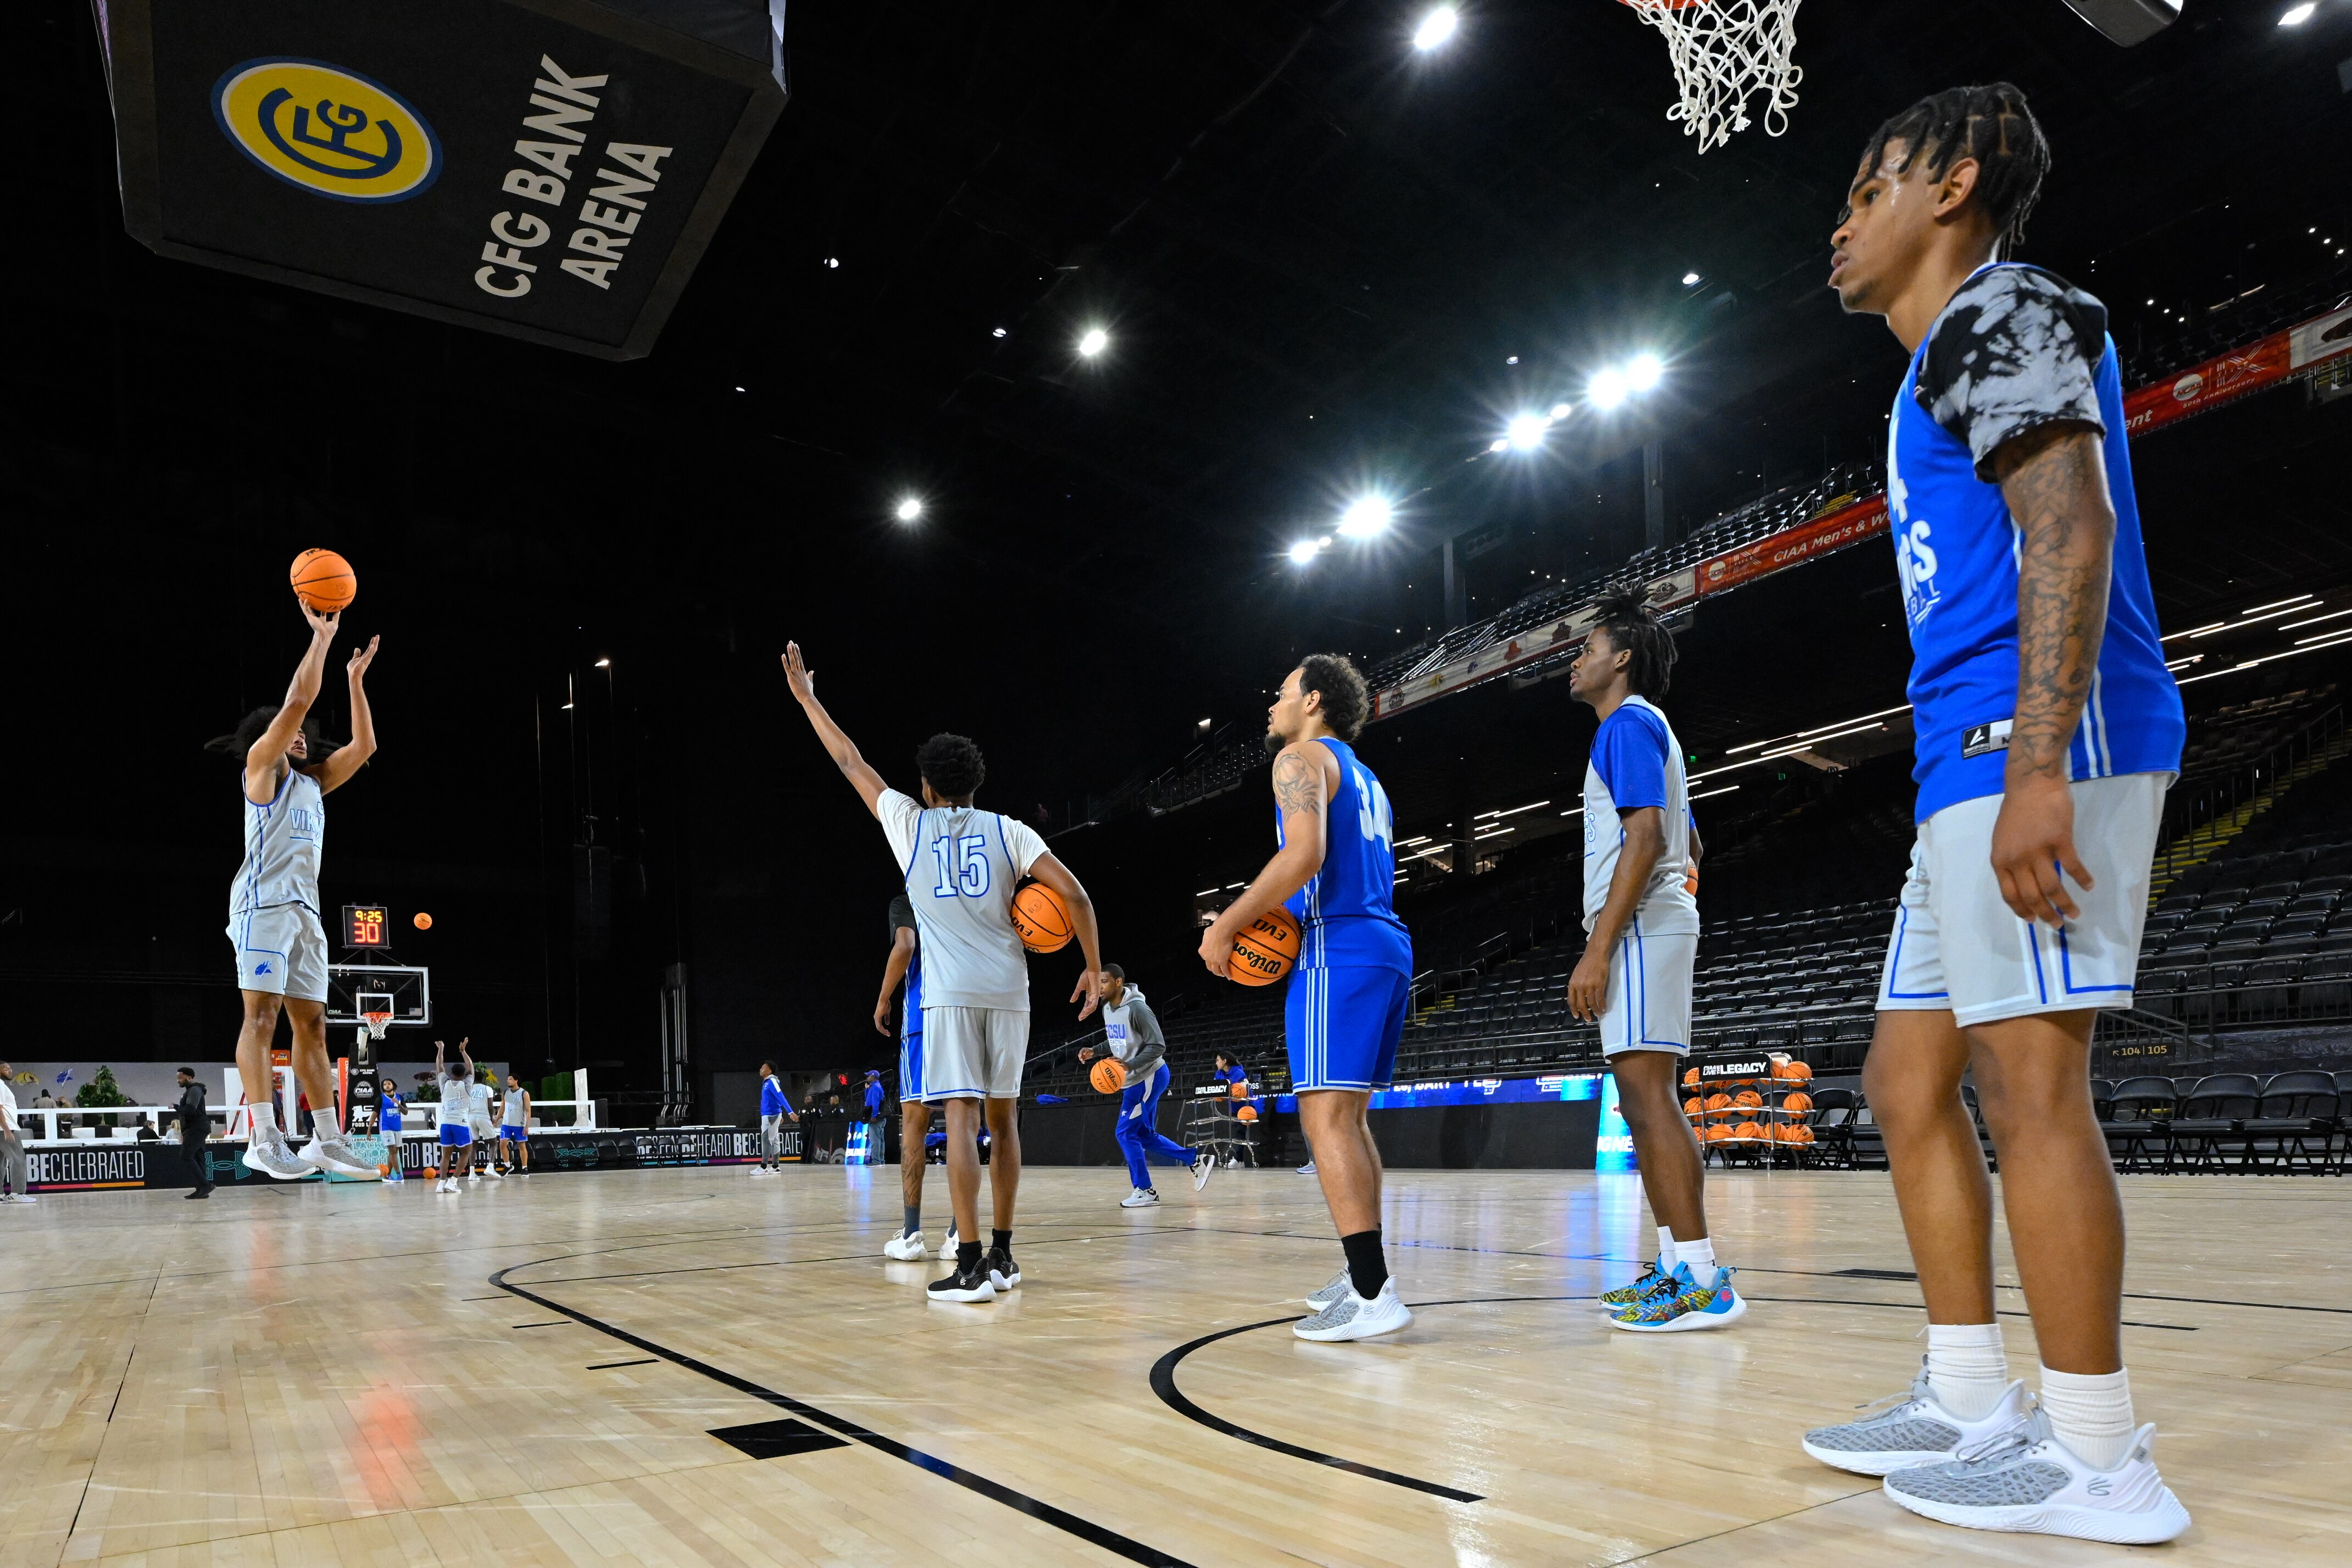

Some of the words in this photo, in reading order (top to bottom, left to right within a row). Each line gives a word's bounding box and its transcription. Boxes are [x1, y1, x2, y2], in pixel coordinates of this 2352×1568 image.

[502, 53, 609, 206] BANK
[560, 142, 673, 290] ARENA
[475, 211, 551, 298] CFG
[2182, 398, 2201, 408] 50th
[2204, 377, 2255, 401] Anniversary
[1773, 542, 1807, 563] CIAA
[1812, 527, 1852, 549] Men's
[1855, 520, 1865, 532] &
[1352, 765, 1393, 855] 34
[931, 835, 989, 898] 15
[355, 910, 382, 923] 9:25
[354, 922, 379, 943] 30
[1252, 919, 1287, 941] EVO
[1233, 941, 1282, 974] Wilson
[2122, 1047, 2140, 1055] 104
[2148, 1045, 2167, 1054] 105
[1104, 1066, 1118, 1088] Wilson
[1720, 1062, 1767, 1075] LEGACY
[457, 1091, 461, 1099] 1
[471, 1088, 483, 1101] 24
[1204, 1085, 1227, 1093] LEGACY
[26, 1150, 144, 1182] BECELEBRATED
